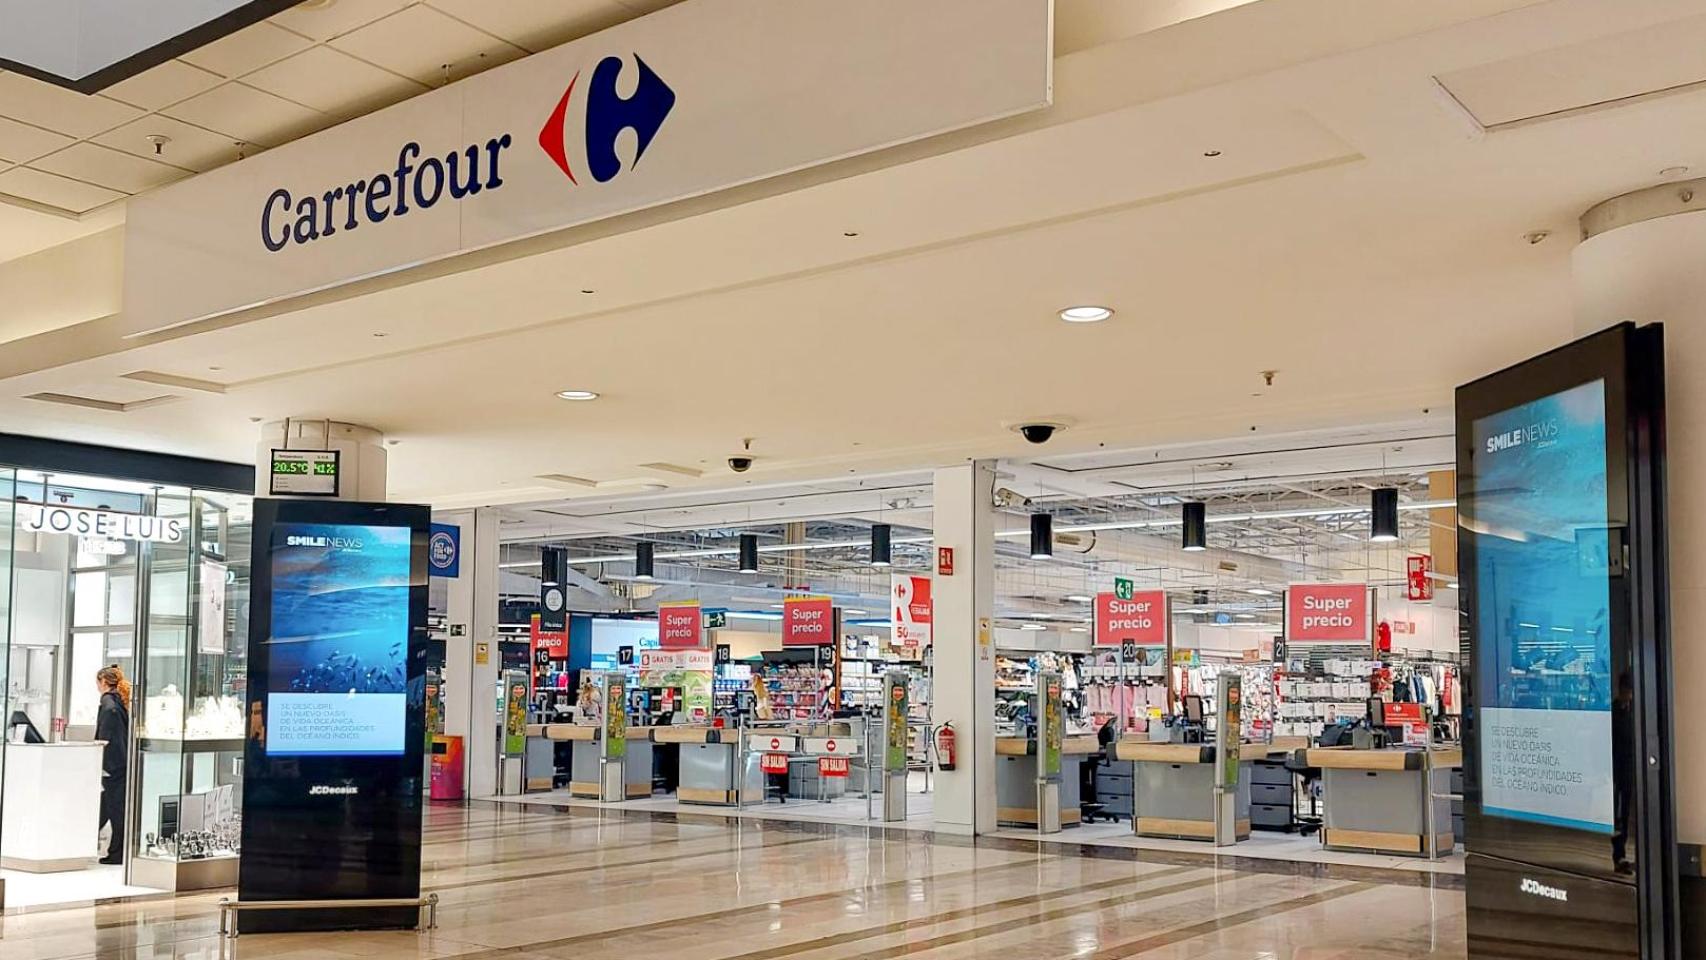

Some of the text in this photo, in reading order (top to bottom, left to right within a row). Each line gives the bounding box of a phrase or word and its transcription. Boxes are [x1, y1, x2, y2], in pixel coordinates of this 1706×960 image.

[261, 133, 512, 252] Carrefour
[31, 508, 180, 541] JOSE LUIS
[1108, 600, 1151, 615] Super
[1304, 595, 1352, 611] Super
[666, 614, 692, 626] Super
[792, 608, 823, 622] Super
[1302, 613, 1353, 630] precio
[792, 624, 823, 635] precio
[1108, 615, 1152, 632] precio
[665, 627, 692, 639] precio
[537, 636, 562, 648] precio
[536, 651, 548, 663] 16
[621, 649, 632, 661] 17
[717, 648, 729, 660] 18
[821, 647, 831, 660] 19
[1123, 643, 1134, 658] 20
[309, 785, 359, 795] JCDecaux
[1520, 878, 1567, 901] JCDecaux
